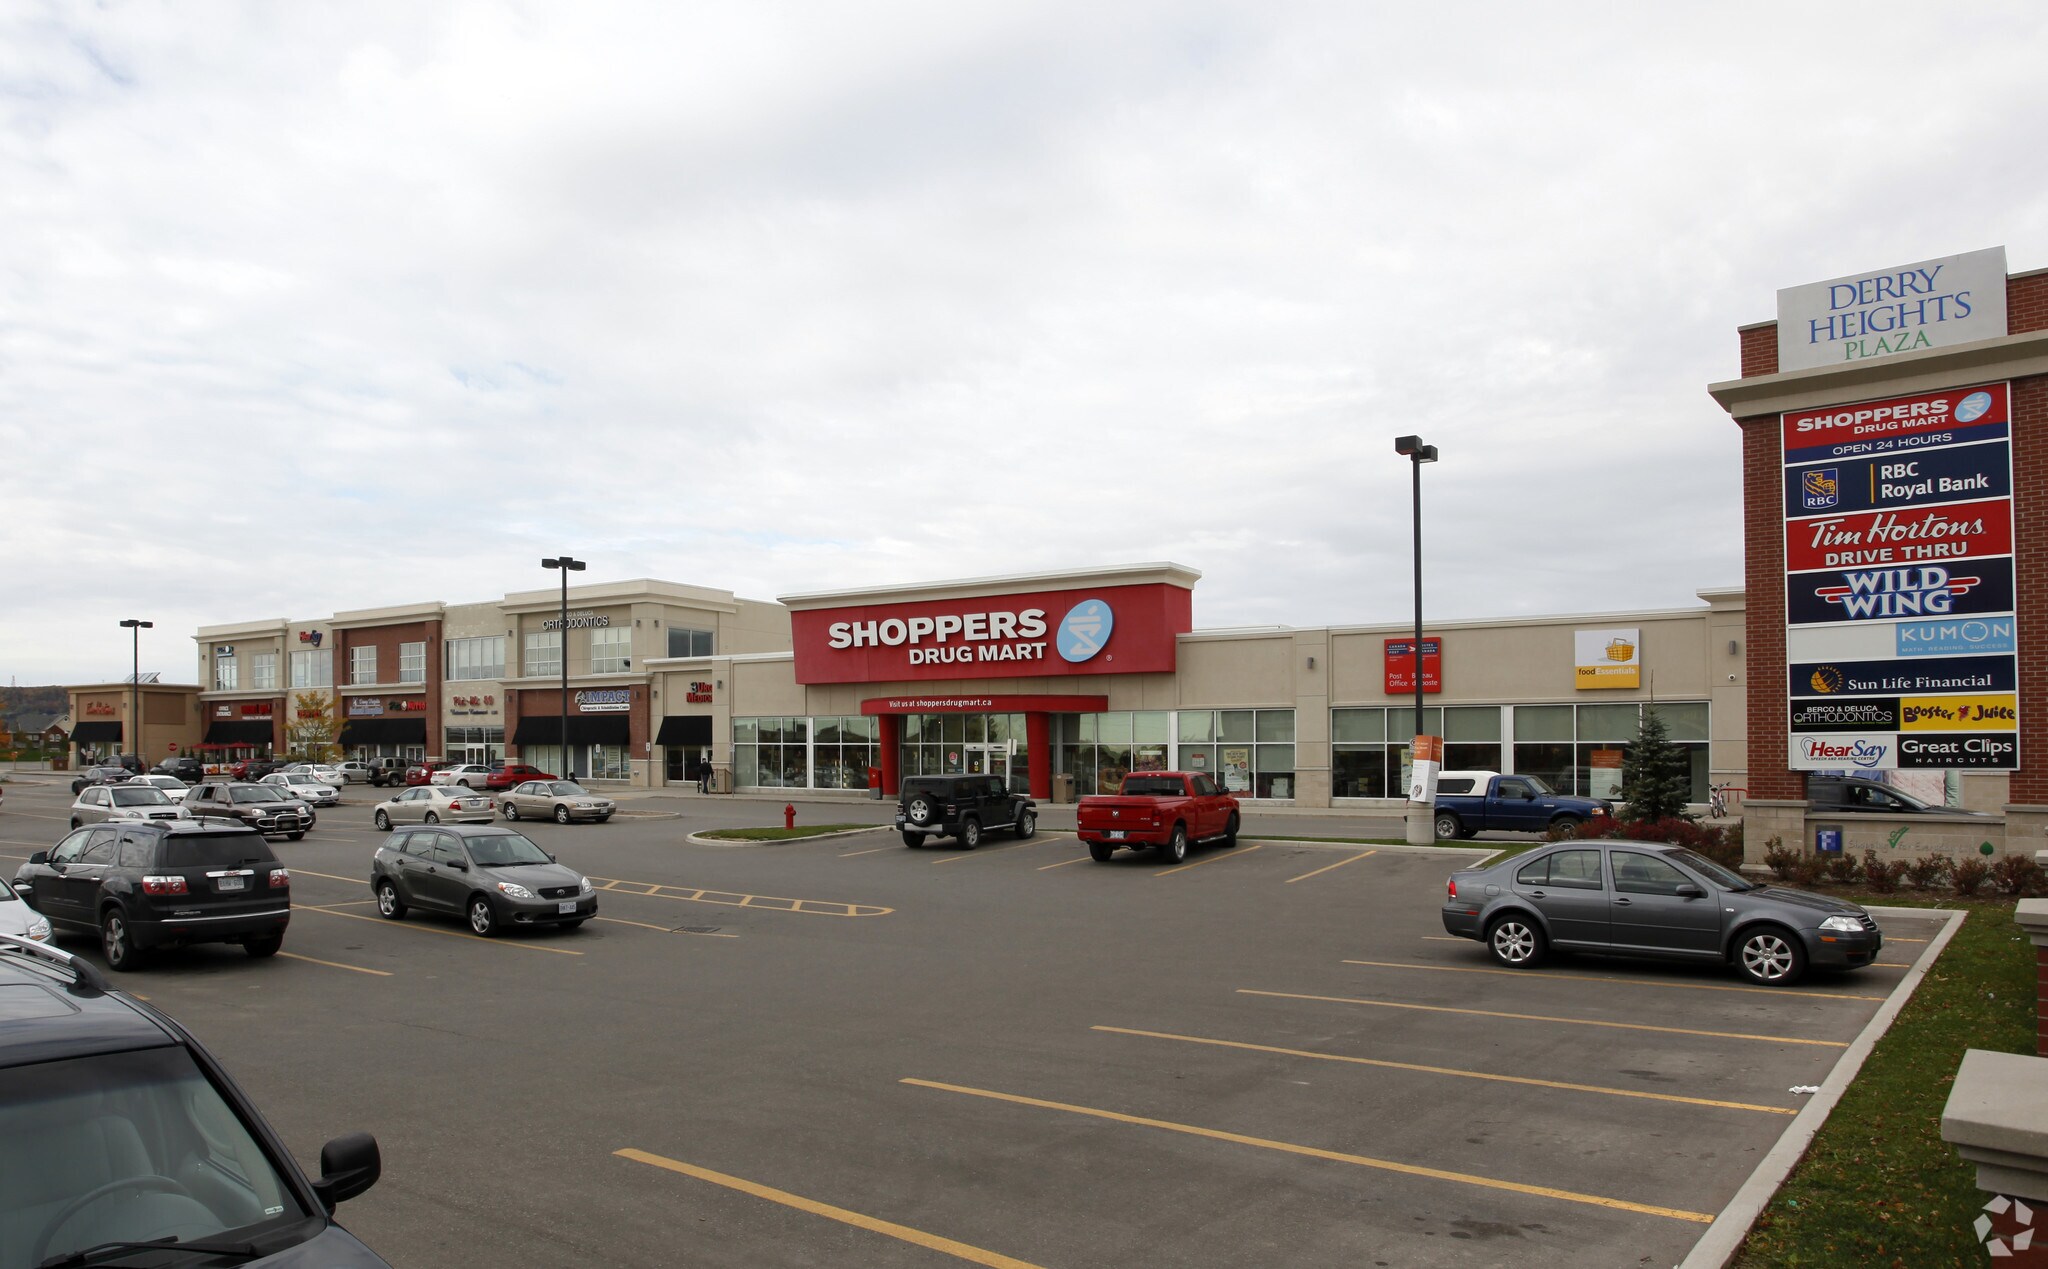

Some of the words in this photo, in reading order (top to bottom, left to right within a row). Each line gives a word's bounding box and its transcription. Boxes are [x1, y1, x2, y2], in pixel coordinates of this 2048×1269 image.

[1828, 265, 1944, 311] DERRY
[1808, 291, 1971, 344] HEIGHTS
[1844, 330, 1932, 360] PLAZA
[1797, 399, 1949, 432] SHOPPERS
[1853, 420, 1898, 435] DRUG
[1902, 414, 1949, 428] MART
[1832, 443, 1872, 456] OPEN
[1876, 440, 1894, 450] 24
[1898, 432, 1952, 447] HOURS
[1881, 462, 1919, 480] RBC
[1881, 479, 1933, 500] Royal
[1938, 473, 1989, 492] Bank
[1807, 495, 1835, 507] RBC
[1808, 518, 1862, 549] Tim
[1866, 513, 1984, 543] Hortons
[1825, 548, 1893, 566] DRIVE
[1901, 541, 1968, 559] THRU
[1844, 566, 1950, 595] WILD
[1841, 589, 1952, 618] WING
[828, 608, 1047, 649] SHOPPERS
[1901, 621, 2010, 642] KUMON
[909, 646, 972, 665] DRUG
[978, 642, 1047, 661] MART
[1848, 679, 1878, 690] Sun
[1882, 677, 1911, 689] Life
[1915, 674, 1992, 688] Financial
[916, 699, 992, 707] shoppersdrugmart.ca
[1903, 706, 1955, 723] Booster
[1972, 705, 2015, 721] Juice
[1793, 711, 1892, 722] ORTHODONTICS
[1810, 740, 1887, 766] HearSay
[1901, 740, 1959, 753] Great
[1964, 738, 2012, 756] Clips
